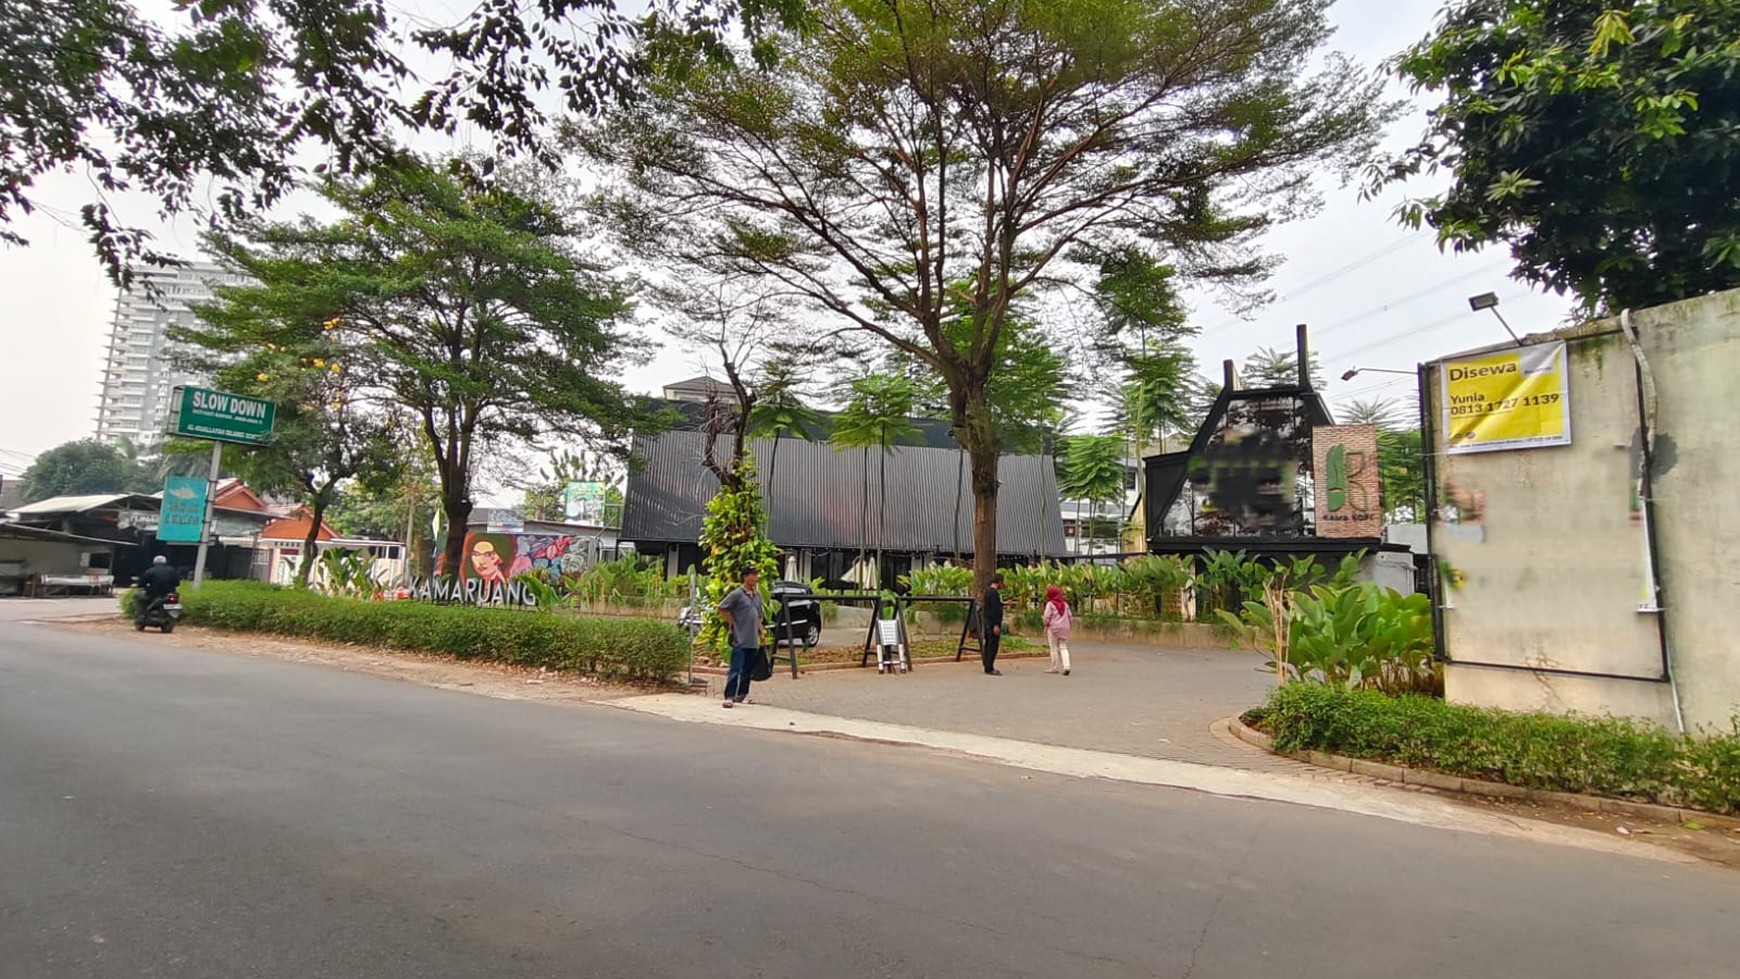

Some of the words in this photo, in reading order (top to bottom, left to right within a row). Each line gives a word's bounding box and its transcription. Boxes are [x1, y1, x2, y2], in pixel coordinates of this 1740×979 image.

[1449, 362, 1515, 381] Disewa
[192, 391, 229, 412] SLOW
[230, 398, 266, 419] DOWN
[1450, 392, 1486, 404] Yunia
[1450, 403, 1483, 416] 0813
[1486, 398, 1518, 412] 1727
[1522, 393, 1559, 407] 1139
[410, 576, 536, 605] KAMARUANG
